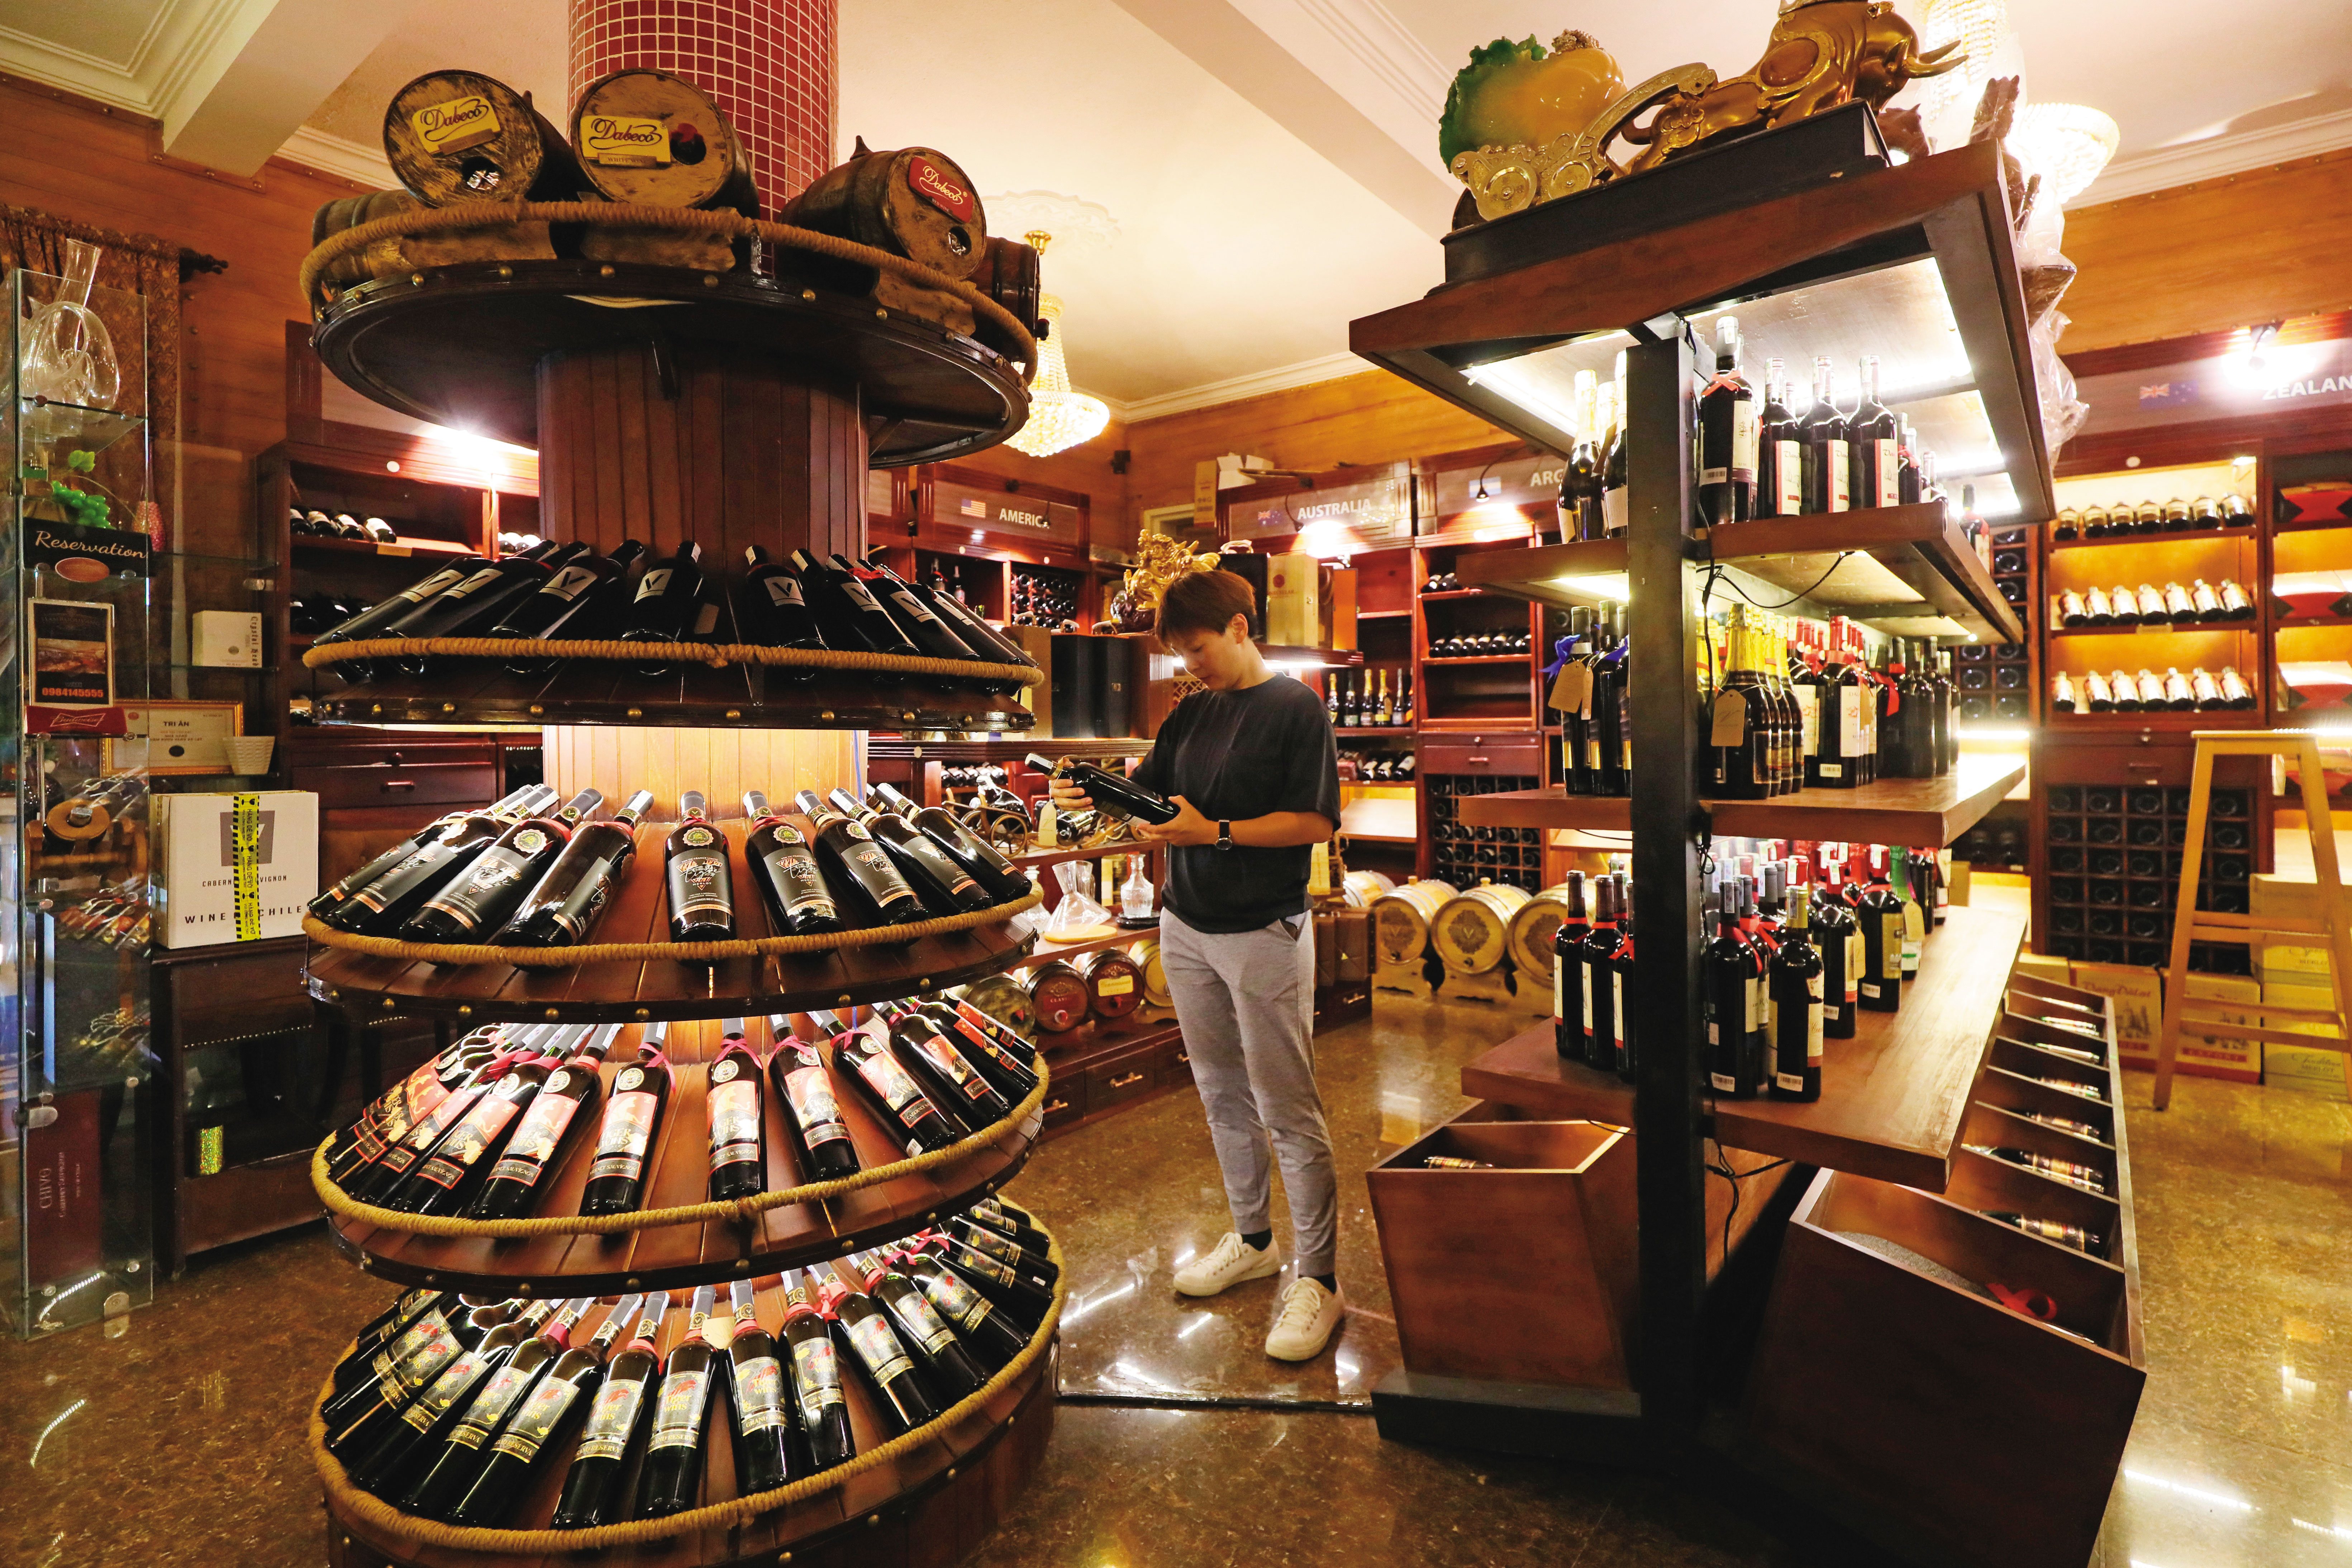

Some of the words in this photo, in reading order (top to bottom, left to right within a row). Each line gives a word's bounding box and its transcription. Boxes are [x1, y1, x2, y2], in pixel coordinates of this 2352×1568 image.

[420, 99, 489, 142] Dabeco
[589, 118, 662, 149] Dabeco
[919, 166, 963, 205] Dabeco
[1297, 498, 1372, 520] AUSTRALIA
[999, 507, 1050, 529] AMERIC
[36, 530, 147, 558] Reservation
[42, 687, 104, 698] 0984145555
[468, 883, 486, 893] MERLOT
[258, 905, 302, 917] CHILE
[185, 912, 226, 924] WINE
[810, 1129, 832, 1141] CABERNET
[726, 1148, 754, 1157] SAUVIGNON
[39, 1168, 52, 1209] CHIVO
[665, 1394, 692, 1404] Tiger
[808, 1392, 829, 1404] GRAND
[664, 1403, 687, 1412] wins
[745, 1415, 767, 1428] GRAND
